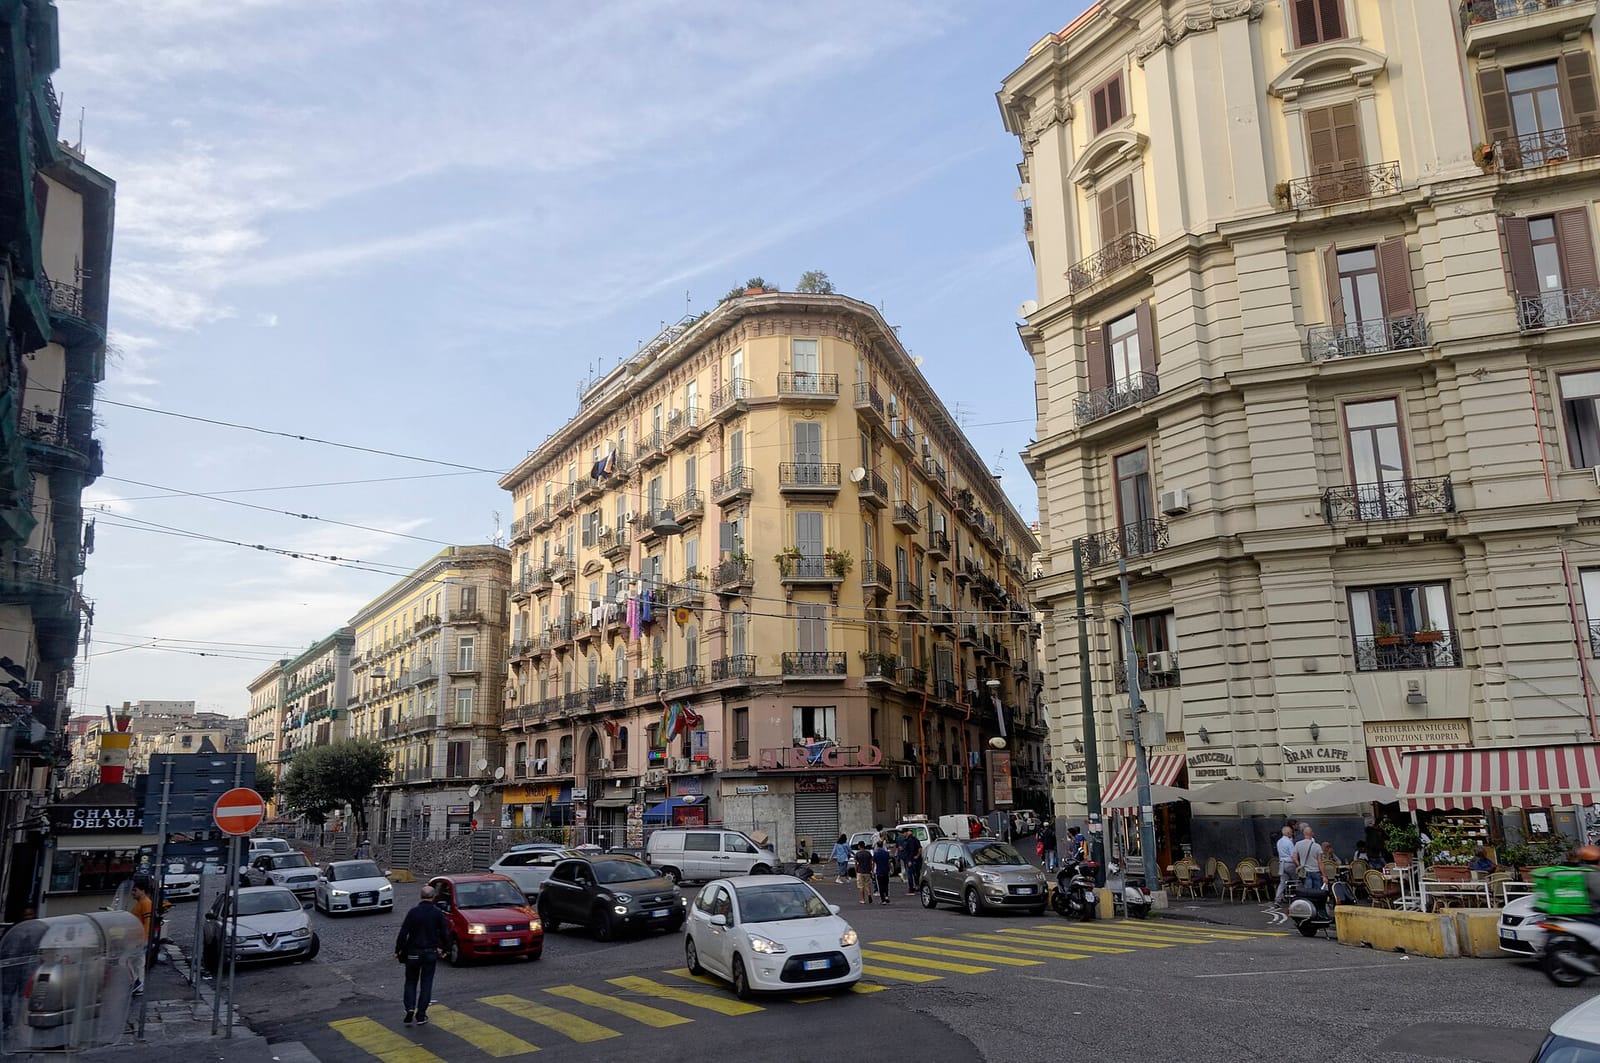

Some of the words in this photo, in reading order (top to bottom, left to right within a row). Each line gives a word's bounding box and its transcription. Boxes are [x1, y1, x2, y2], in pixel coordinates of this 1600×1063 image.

[1366, 724, 1415, 733] CAFFETTERIA
[1416, 722, 1466, 732] PASTICCERIA
[1375, 733, 1424, 743] PRODUZIONE
[1425, 732, 1460, 741] PROPRIA
[759, 745, 882, 768] ARGO
[1188, 752, 1233, 766] PASTICCERIA
[1284, 748, 1314, 763] GRAN
[1296, 765, 1341, 773] IMPERIUS
[72, 818, 104, 829] DEL
